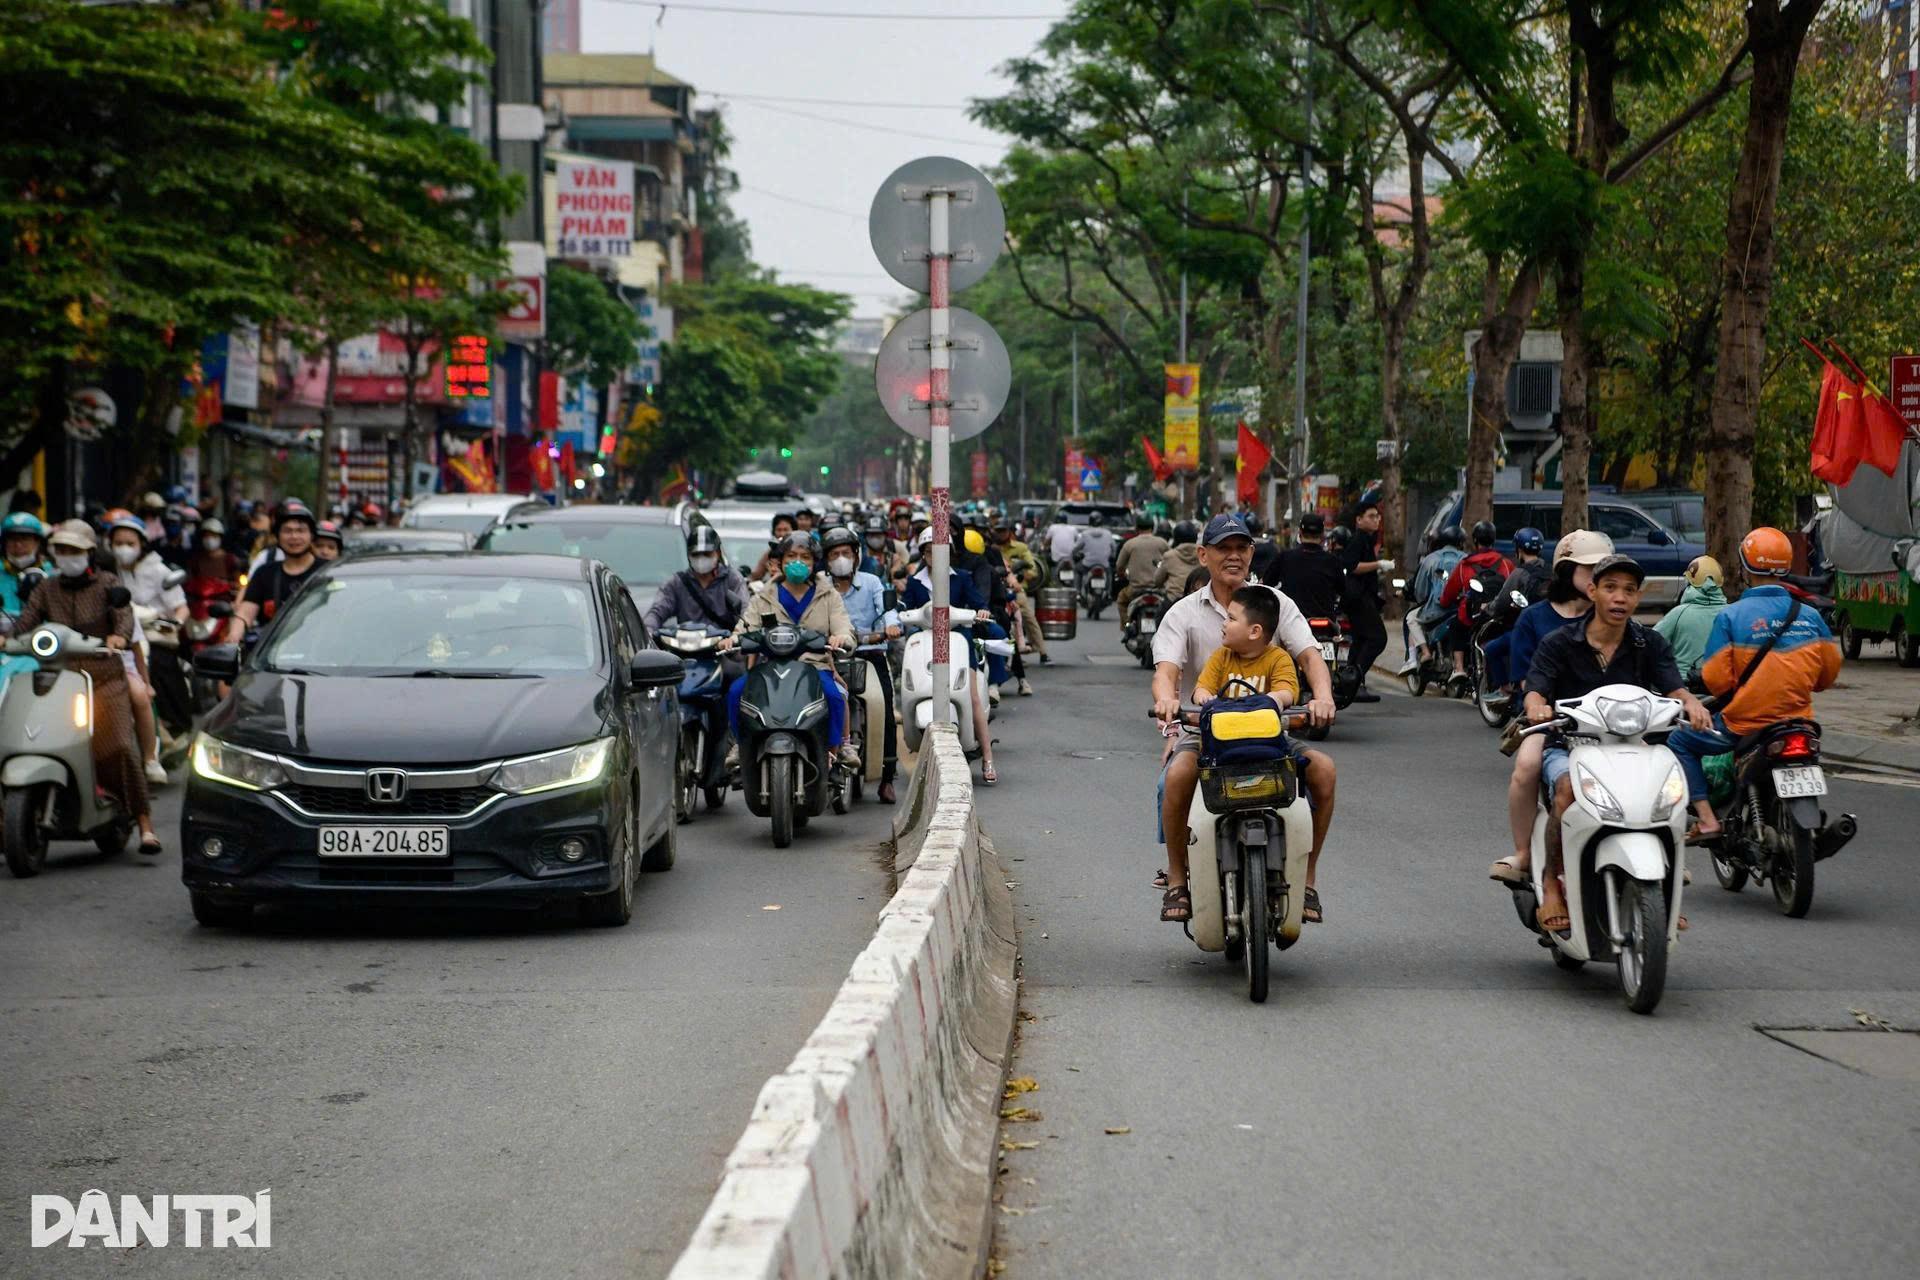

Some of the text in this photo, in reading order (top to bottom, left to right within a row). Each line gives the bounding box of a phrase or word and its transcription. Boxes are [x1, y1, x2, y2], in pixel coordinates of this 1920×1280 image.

[1780, 767, 1817, 782] 29-C1
[1780, 781, 1823, 796] 923.39
[323, 830, 444, 853] 98A-204.85
